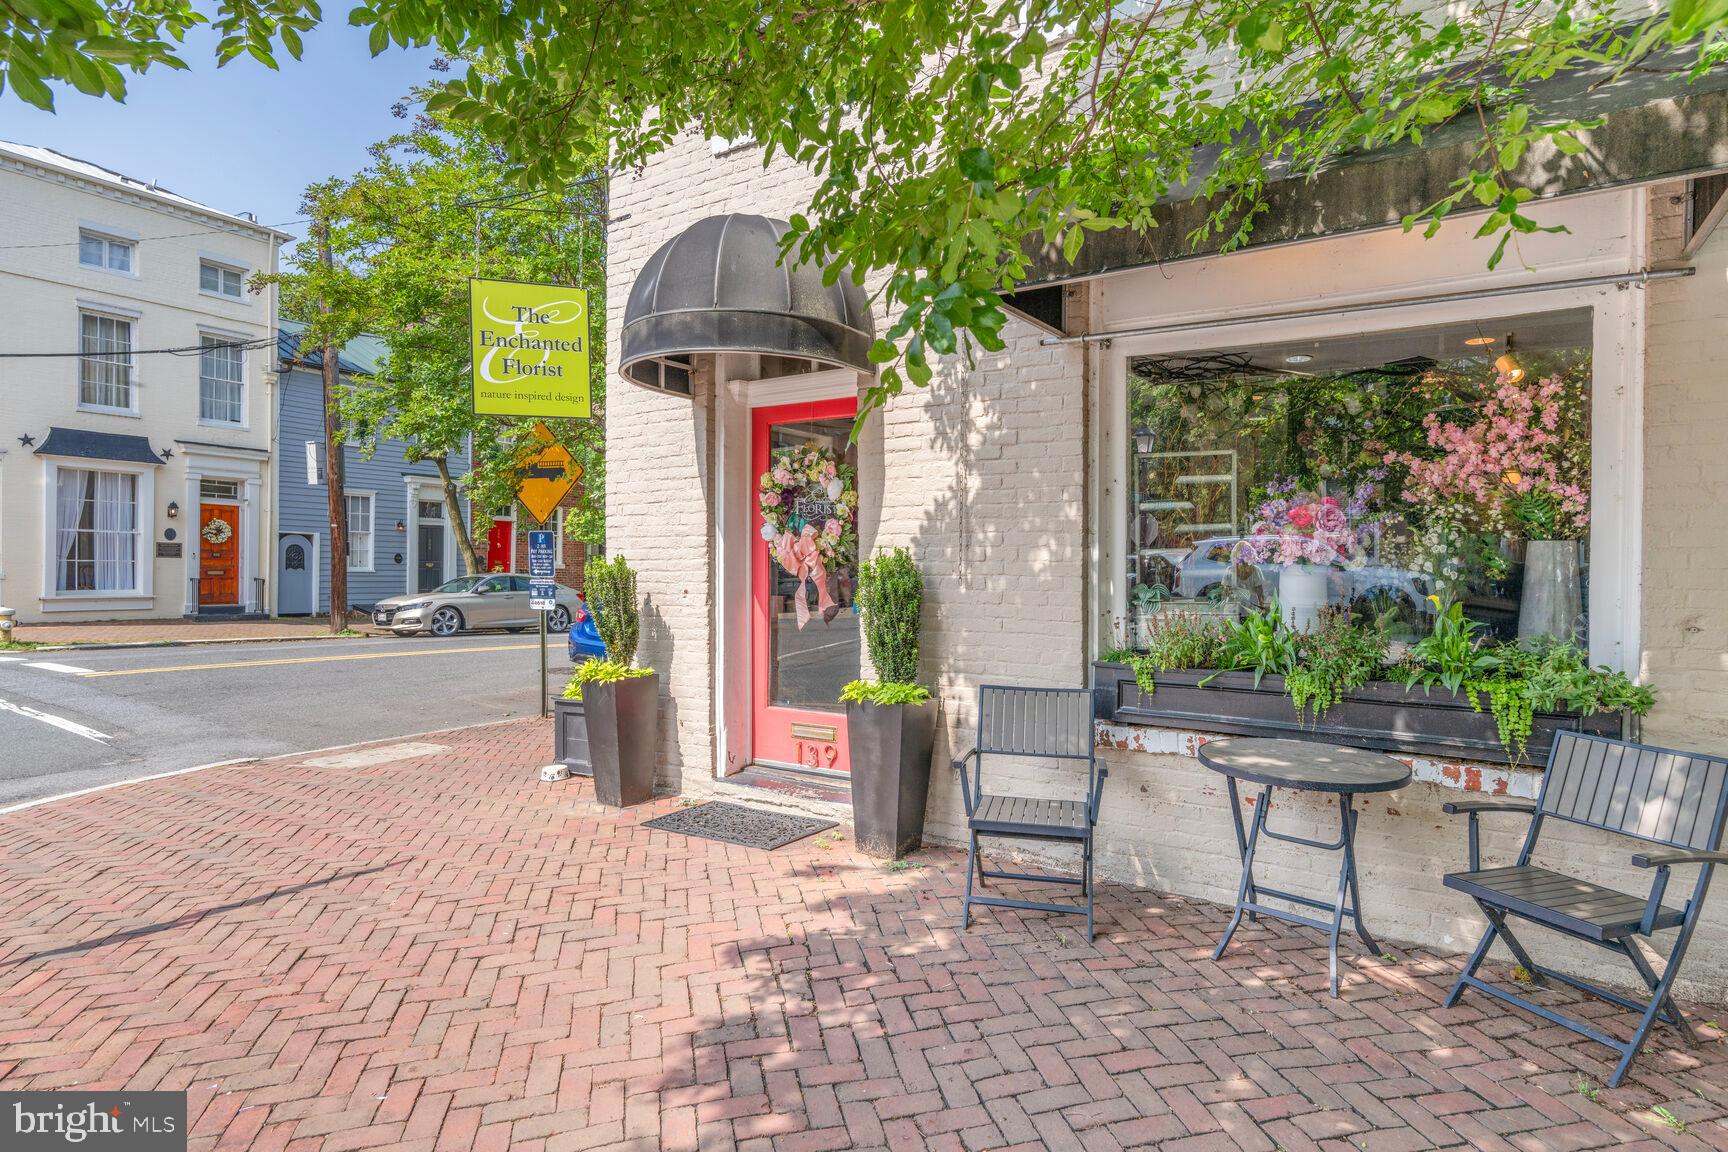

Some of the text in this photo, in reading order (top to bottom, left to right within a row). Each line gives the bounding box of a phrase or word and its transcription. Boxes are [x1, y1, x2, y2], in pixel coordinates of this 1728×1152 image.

[512, 306, 550, 324] The
[480, 330, 582, 352] Enchanted
[502, 358, 563, 377] Florist
[480, 390, 584, 403] nature inspired design
[795, 501, 837, 515] FLORIST
[797, 742, 838, 769] 139
